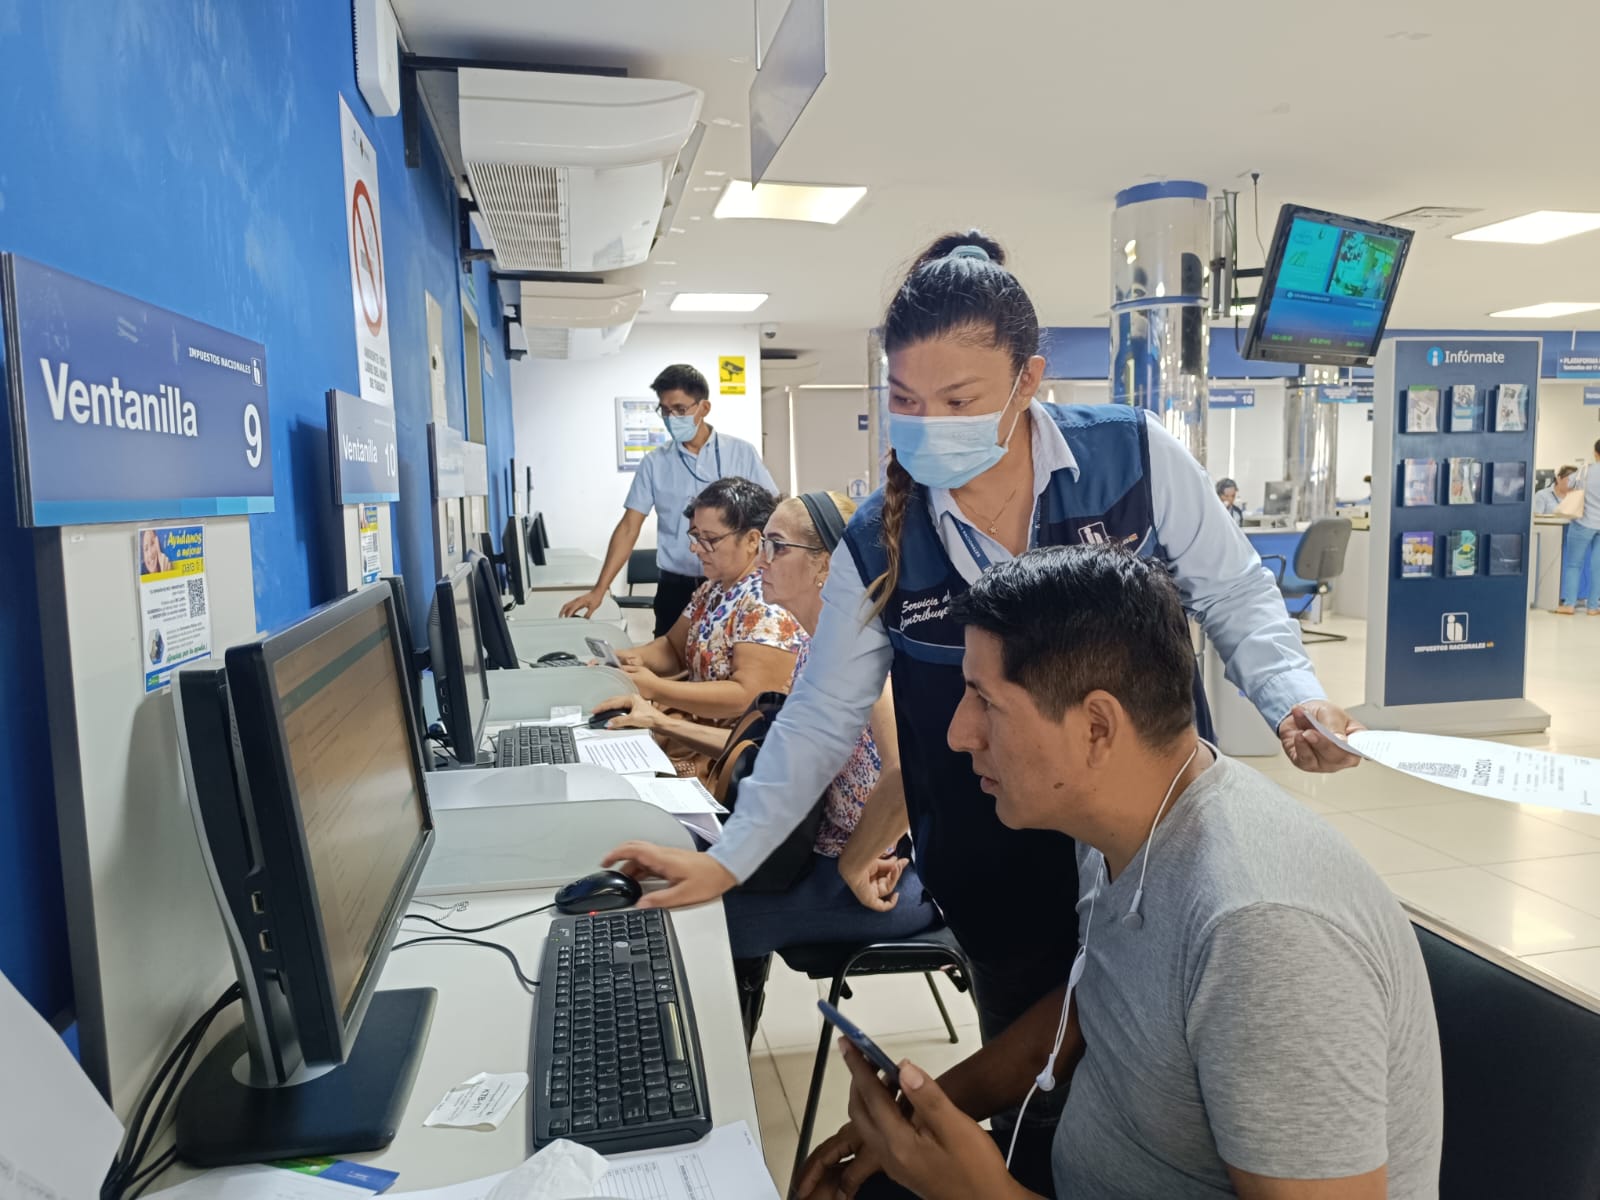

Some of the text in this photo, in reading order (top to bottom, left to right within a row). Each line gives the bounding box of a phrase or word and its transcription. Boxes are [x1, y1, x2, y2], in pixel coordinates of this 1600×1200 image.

[188, 346, 251, 374] IMPUESTOS NACIONALES
[1445, 349, 1505, 364] Infórmate
[40, 357, 262, 468] Ventanilla 9
[342, 433, 396, 477] Ventanilla 10
[901, 597, 939, 614] Servicio
[900, 606, 950, 632] Contribuye
[1414, 642, 1486, 653] IMPUESTOS NACIONALES
